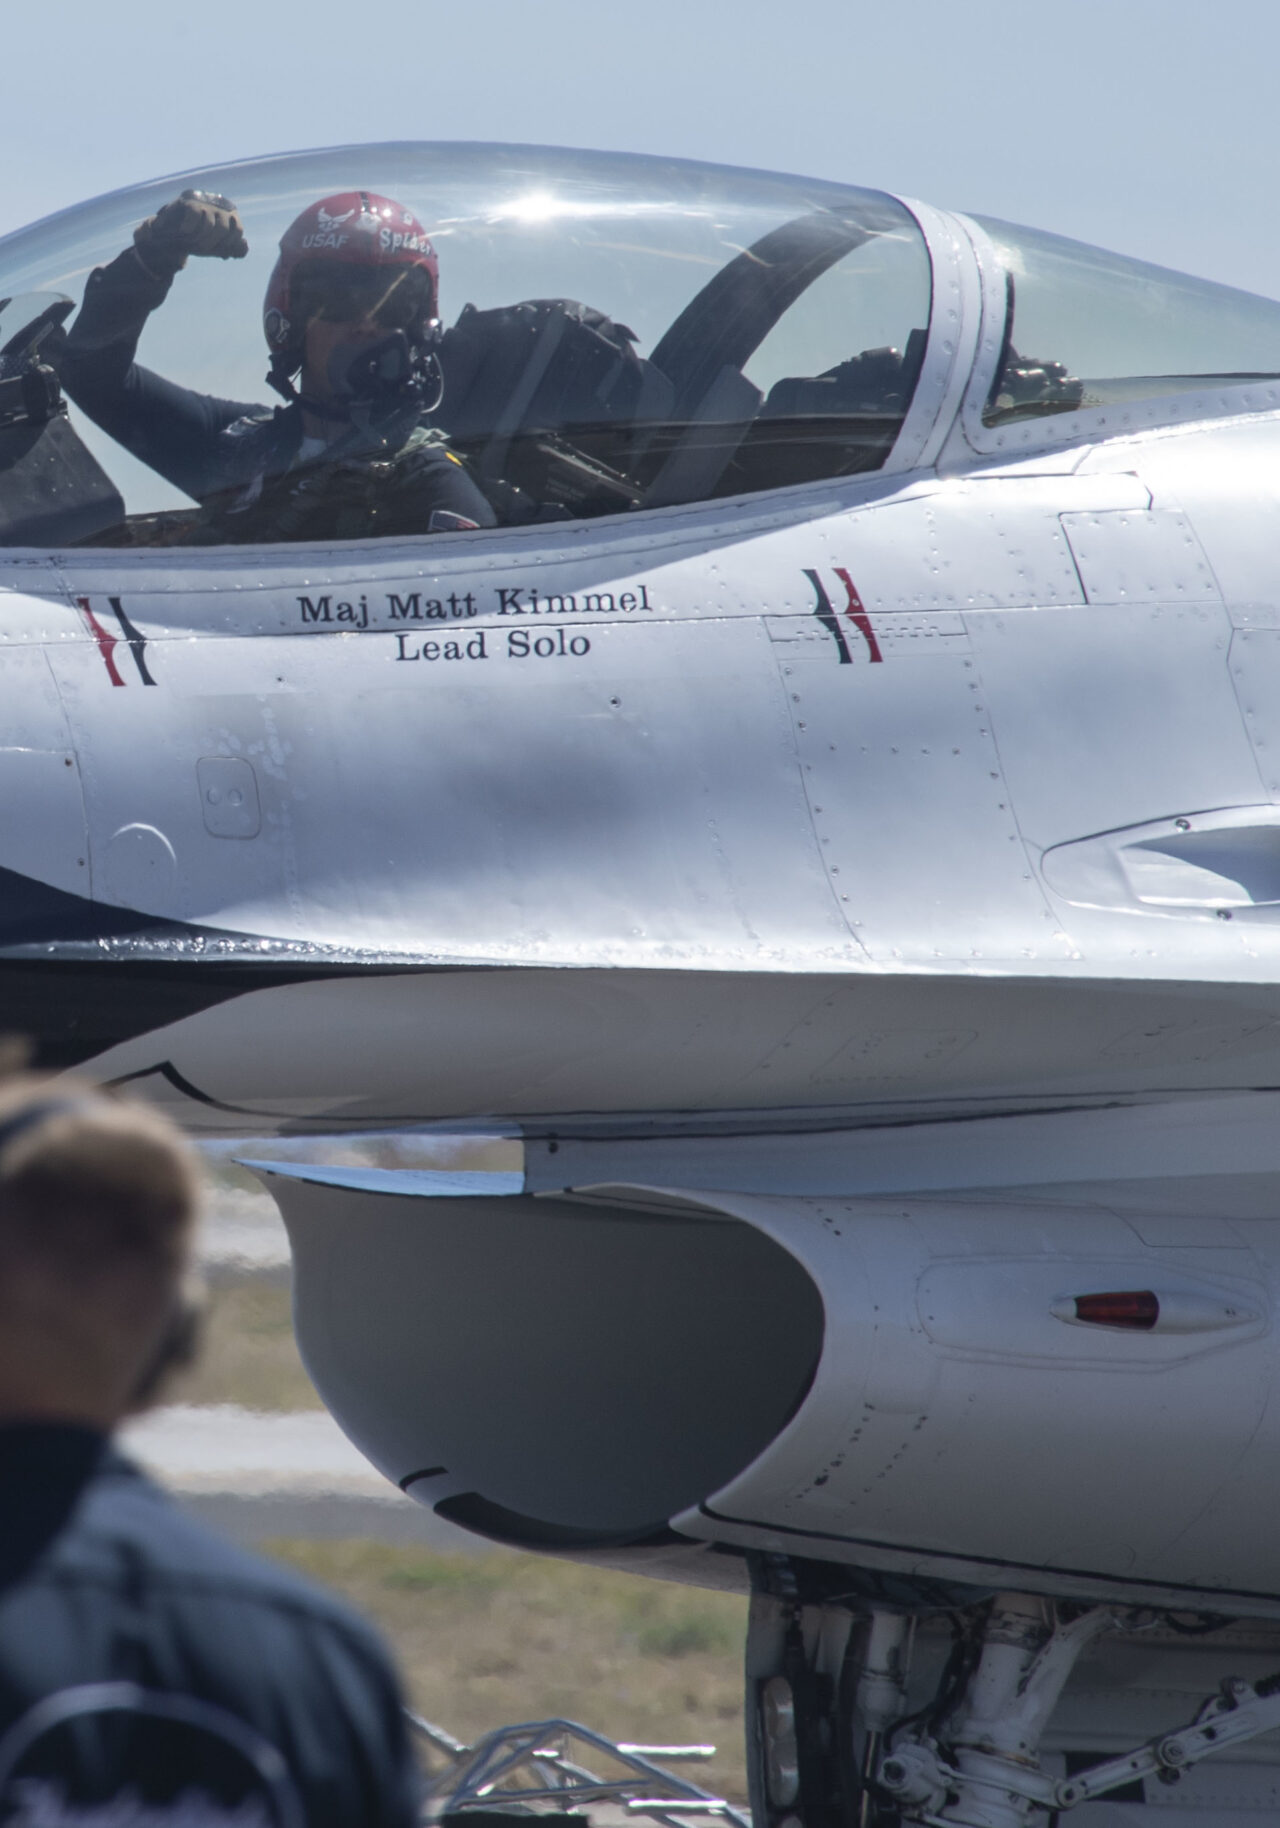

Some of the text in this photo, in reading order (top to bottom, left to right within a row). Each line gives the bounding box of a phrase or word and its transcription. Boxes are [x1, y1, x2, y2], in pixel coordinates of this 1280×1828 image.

[302, 233, 349, 249] USAF
[296, 585, 653, 628] Maj Matt Kimmel
[395, 628, 591, 661] Lead Solo
